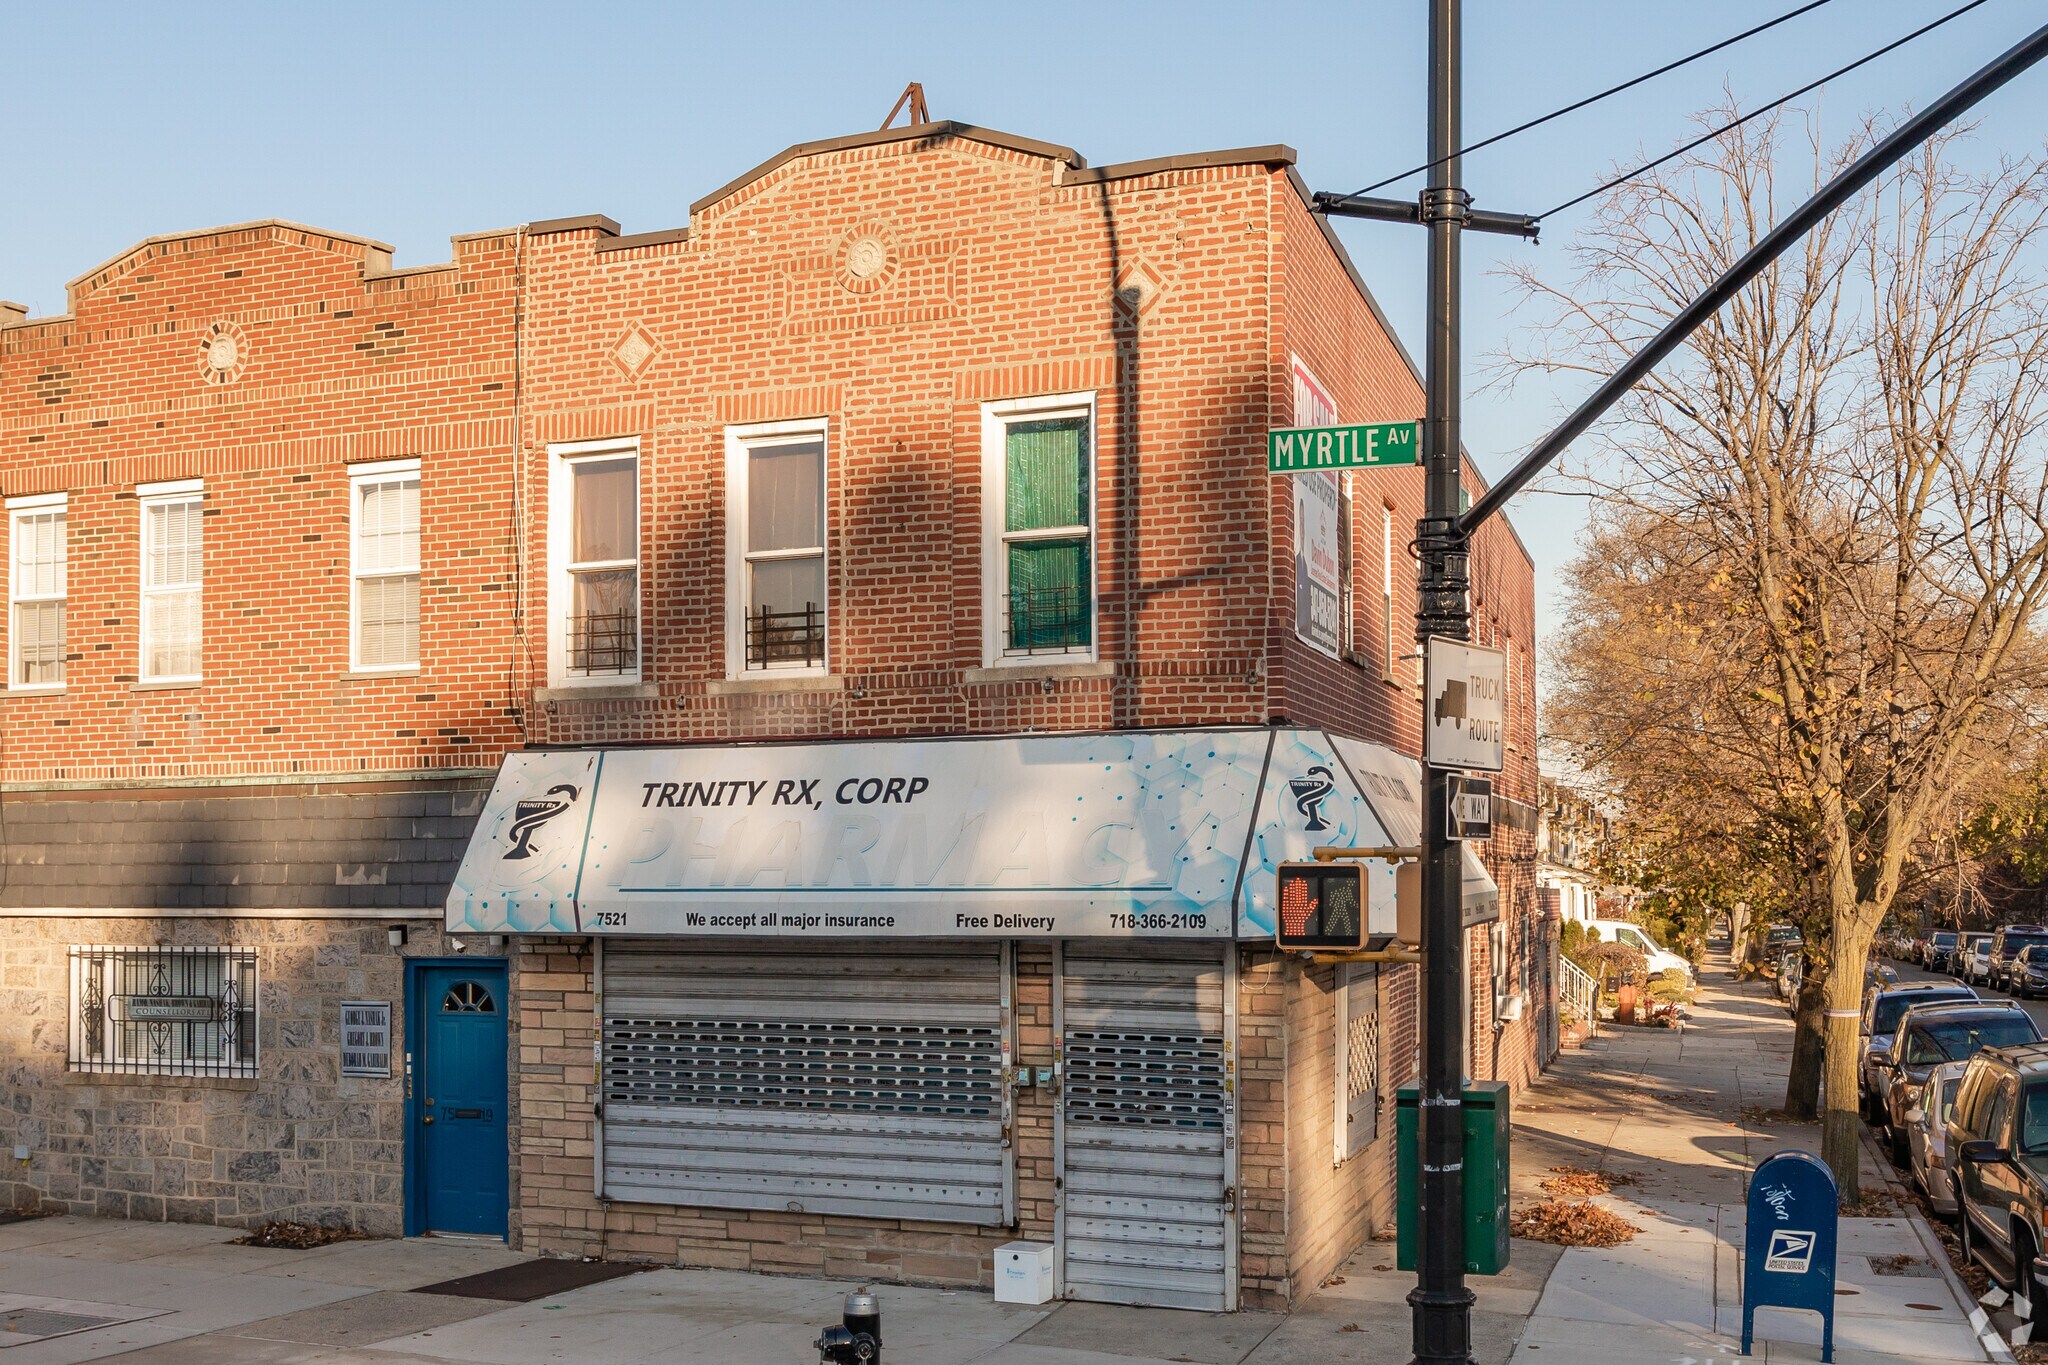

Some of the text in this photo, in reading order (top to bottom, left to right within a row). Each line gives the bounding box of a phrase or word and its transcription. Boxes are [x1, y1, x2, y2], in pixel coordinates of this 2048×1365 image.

[1275, 428, 1410, 467] MYRTLE Av
[1470, 675, 1500, 702] TRUCK
[1469, 721, 1499, 743] ROUTE
[641, 777, 929, 810] TRINITY RX, CORP
[1471, 797, 1486, 820] WAY
[597, 911, 1207, 931] 7521 We accept all major insurance Free Delivery 718-366-2109
[441, 1106, 455, 1120] 75
